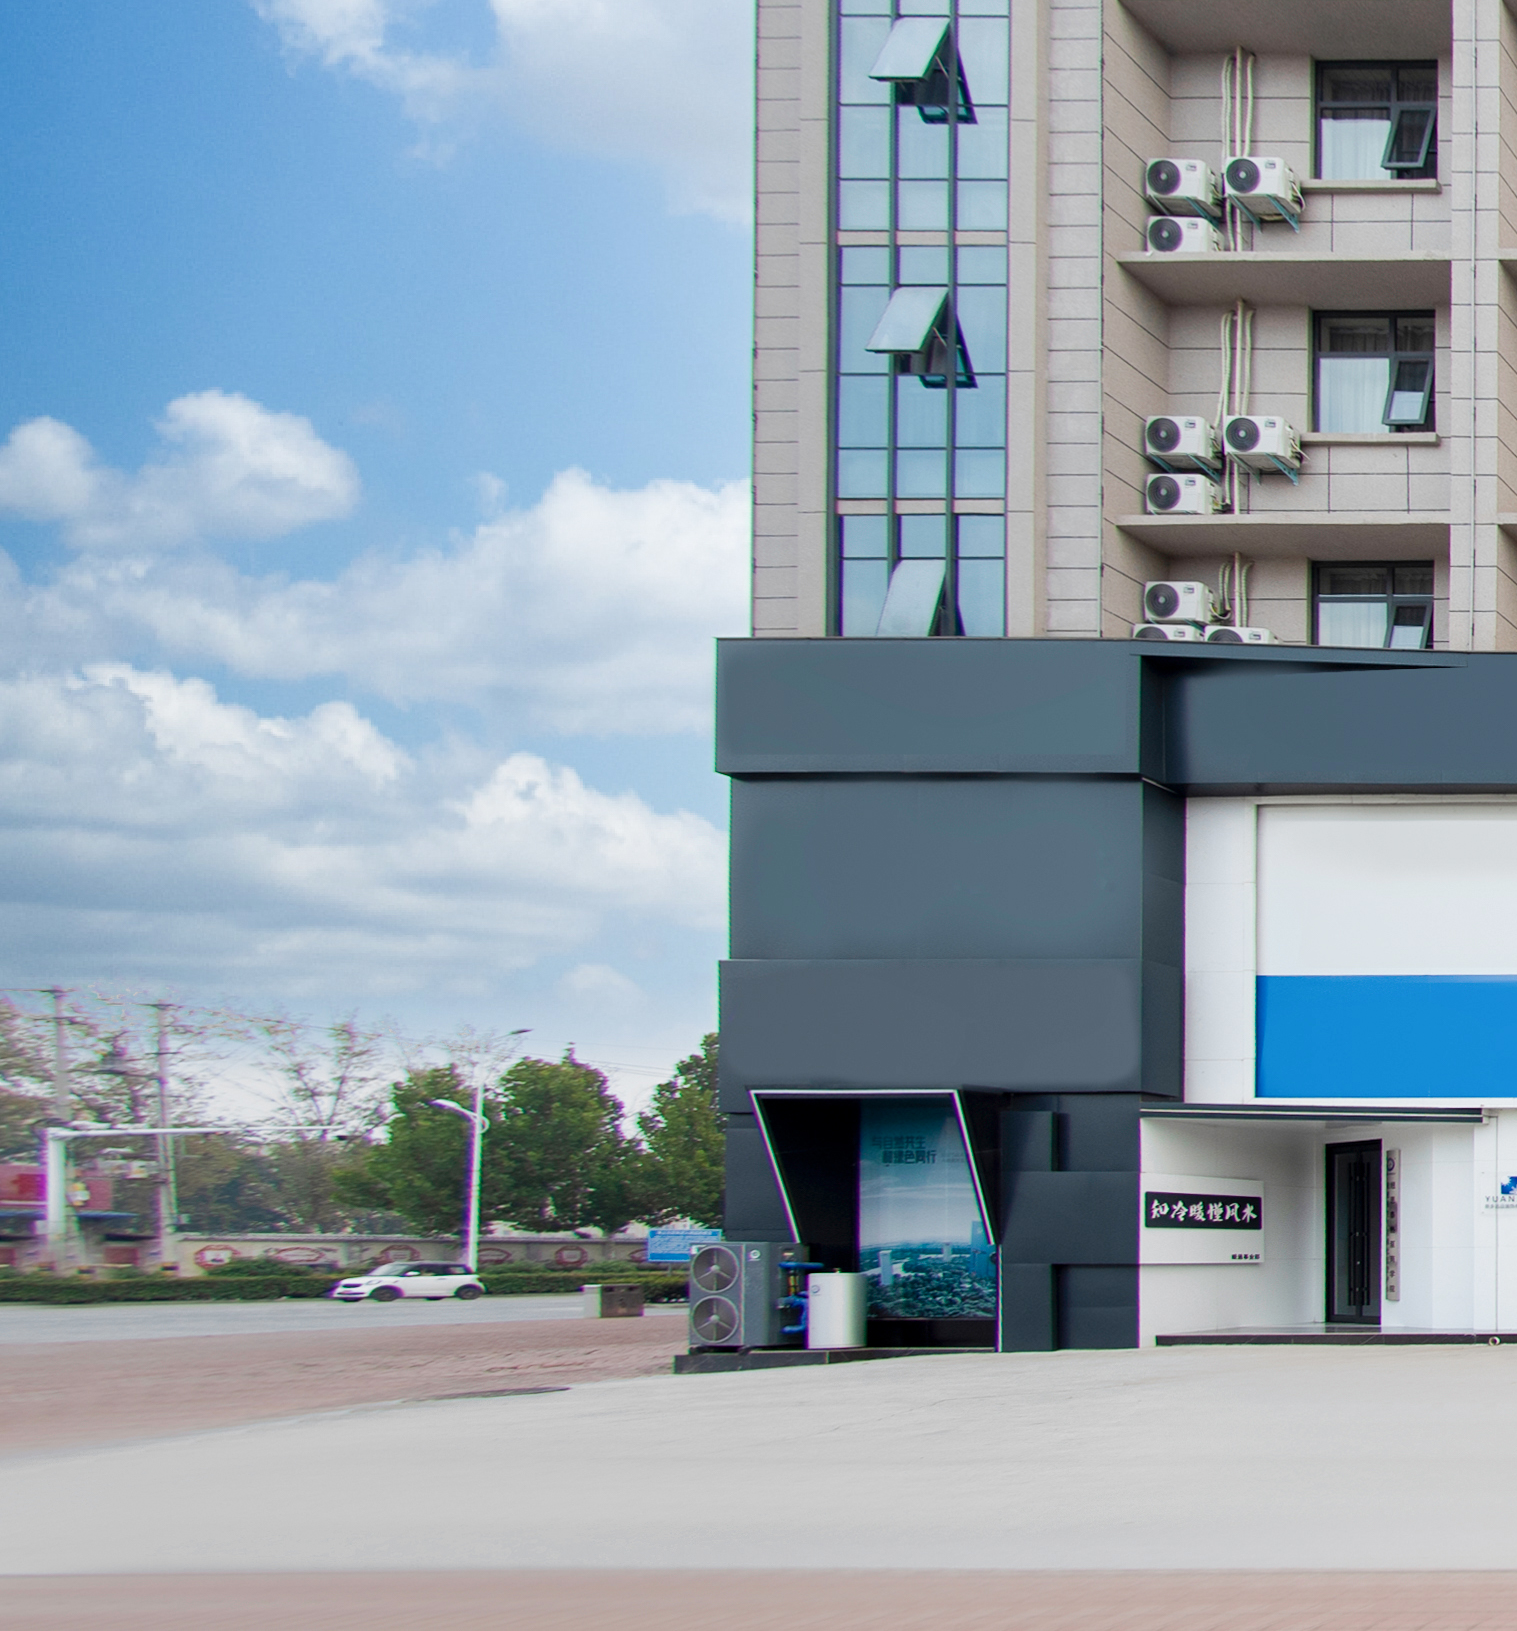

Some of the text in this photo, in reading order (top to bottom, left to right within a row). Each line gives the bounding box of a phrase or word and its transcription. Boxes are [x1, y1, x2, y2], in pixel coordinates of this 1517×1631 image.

[1151, 1198, 1258, 1223] 知冷暖懂风水
